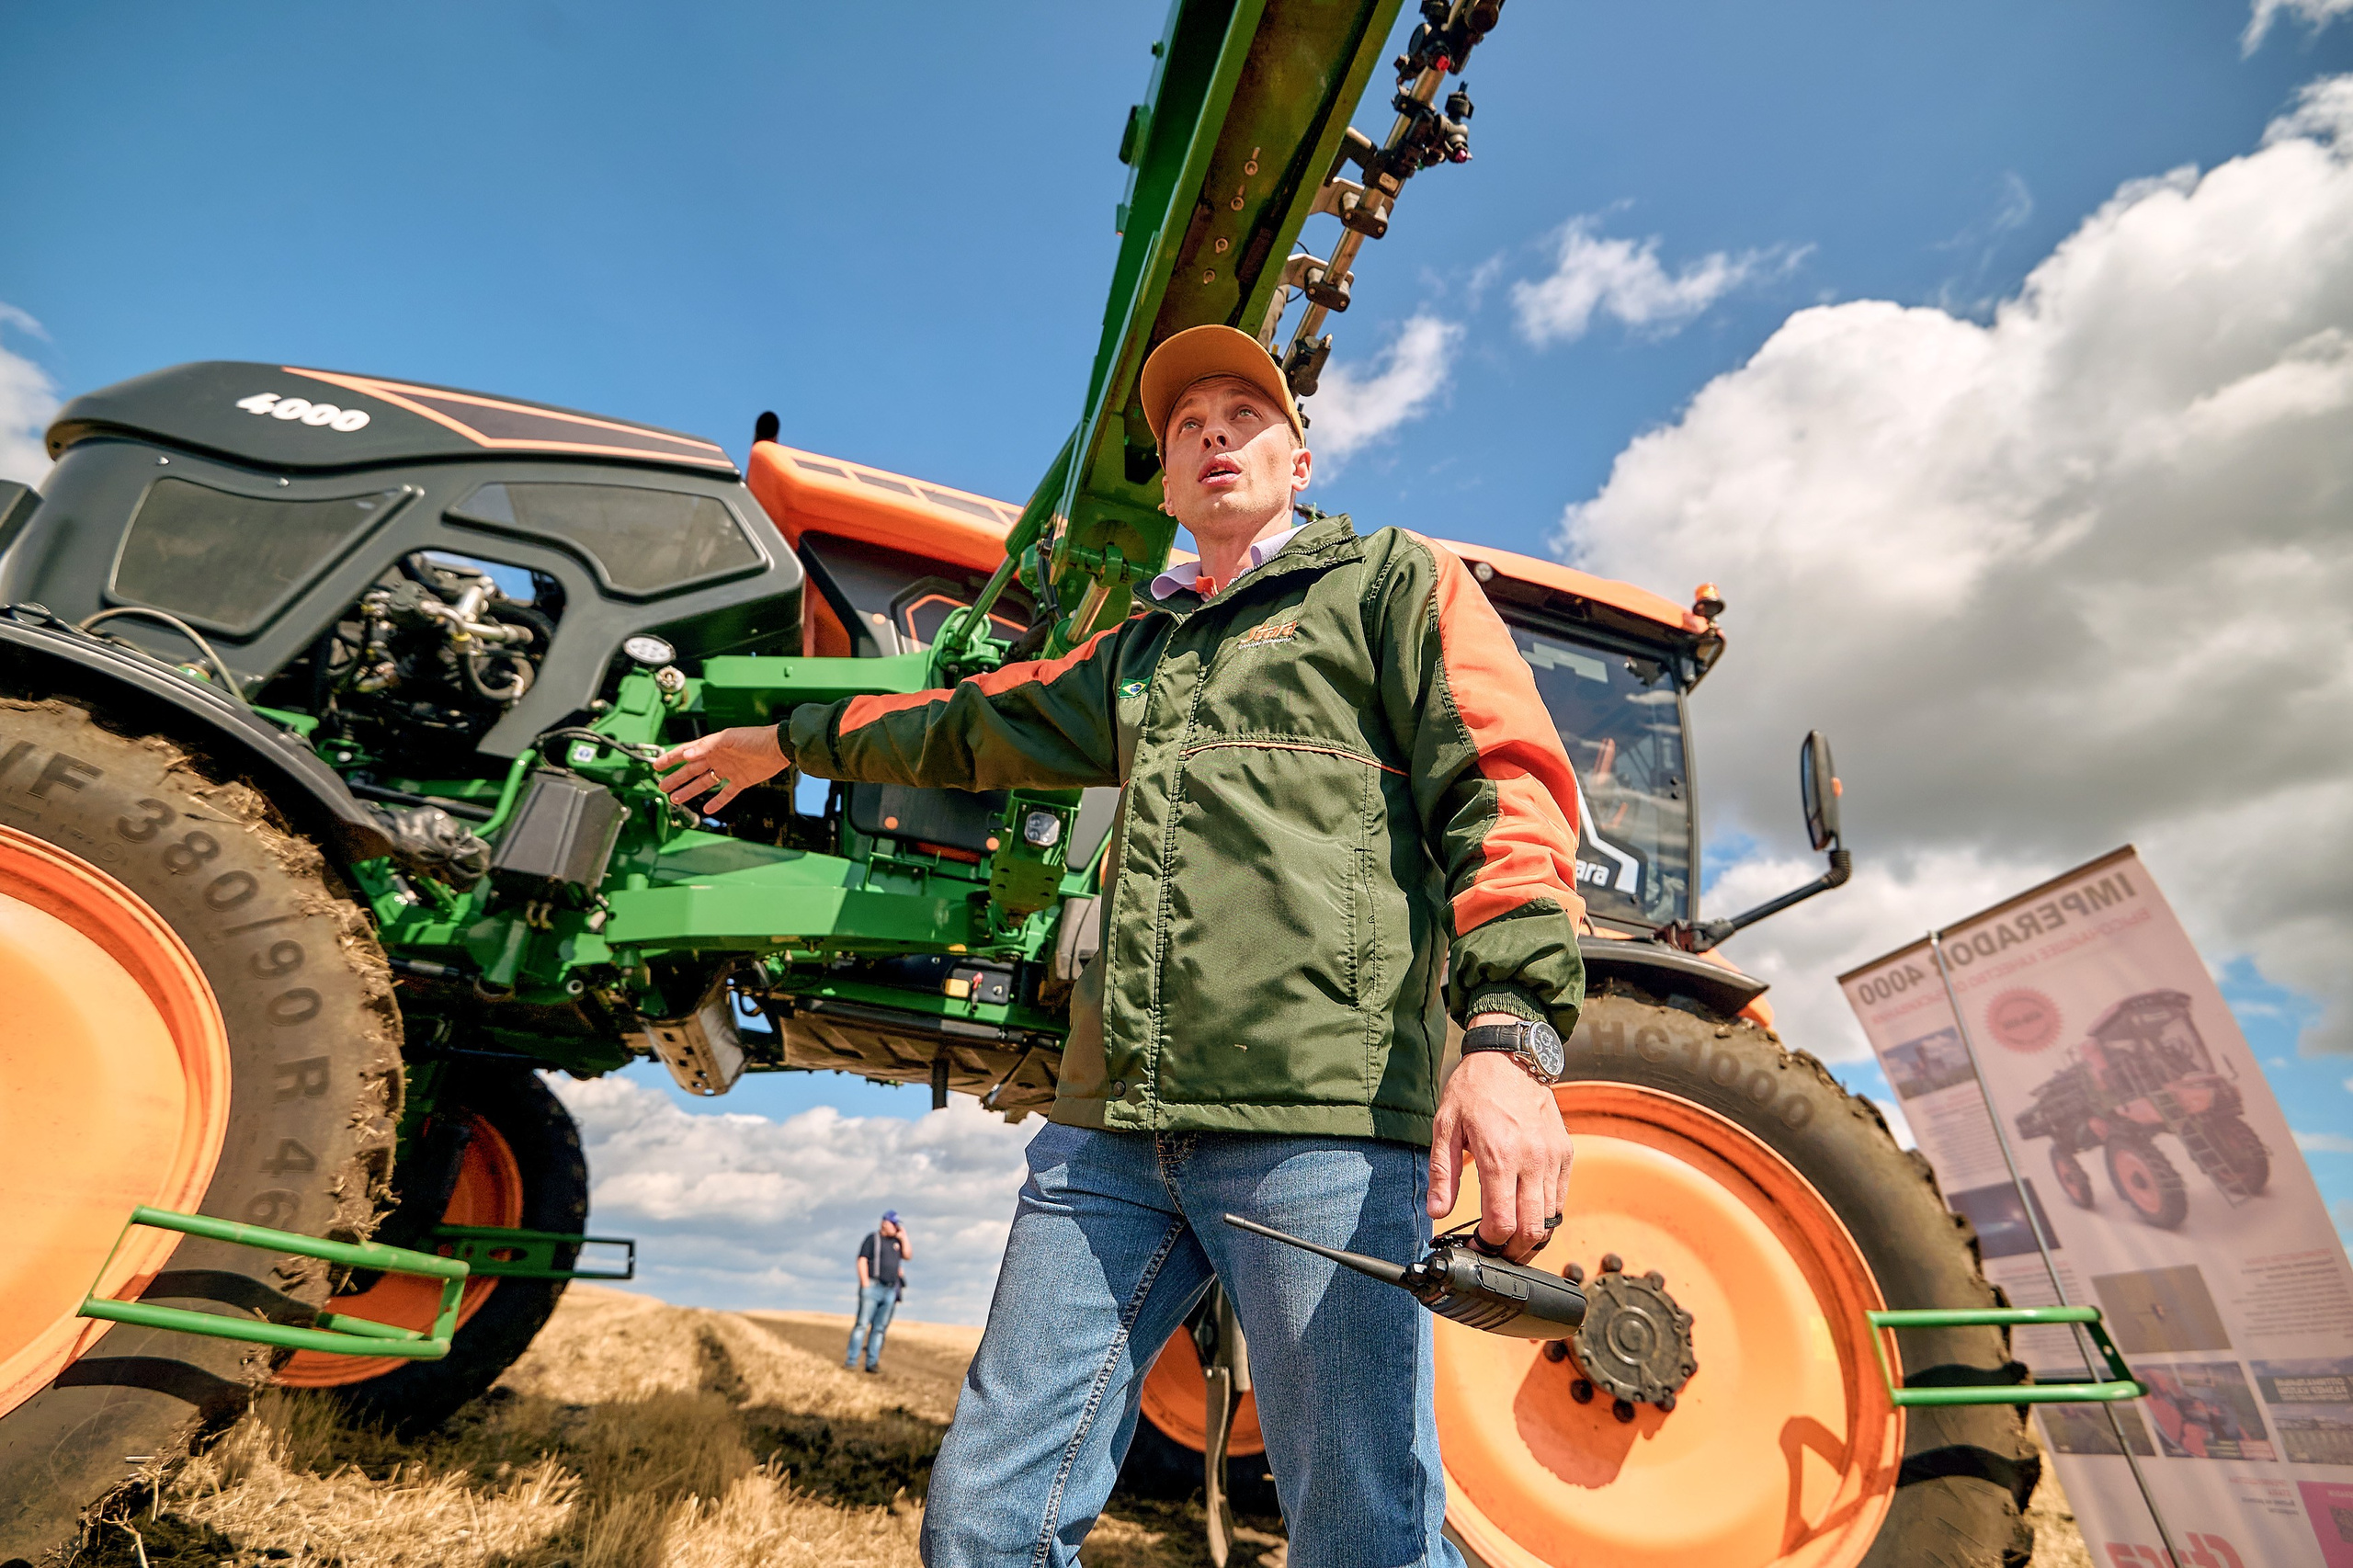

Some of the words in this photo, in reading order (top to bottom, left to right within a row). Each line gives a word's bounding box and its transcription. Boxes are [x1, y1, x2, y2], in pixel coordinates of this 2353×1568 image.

[235, 392, 371, 432] 4000
[117, 798, 324, 1028] 380/90
[275, 1055, 331, 1102] R
